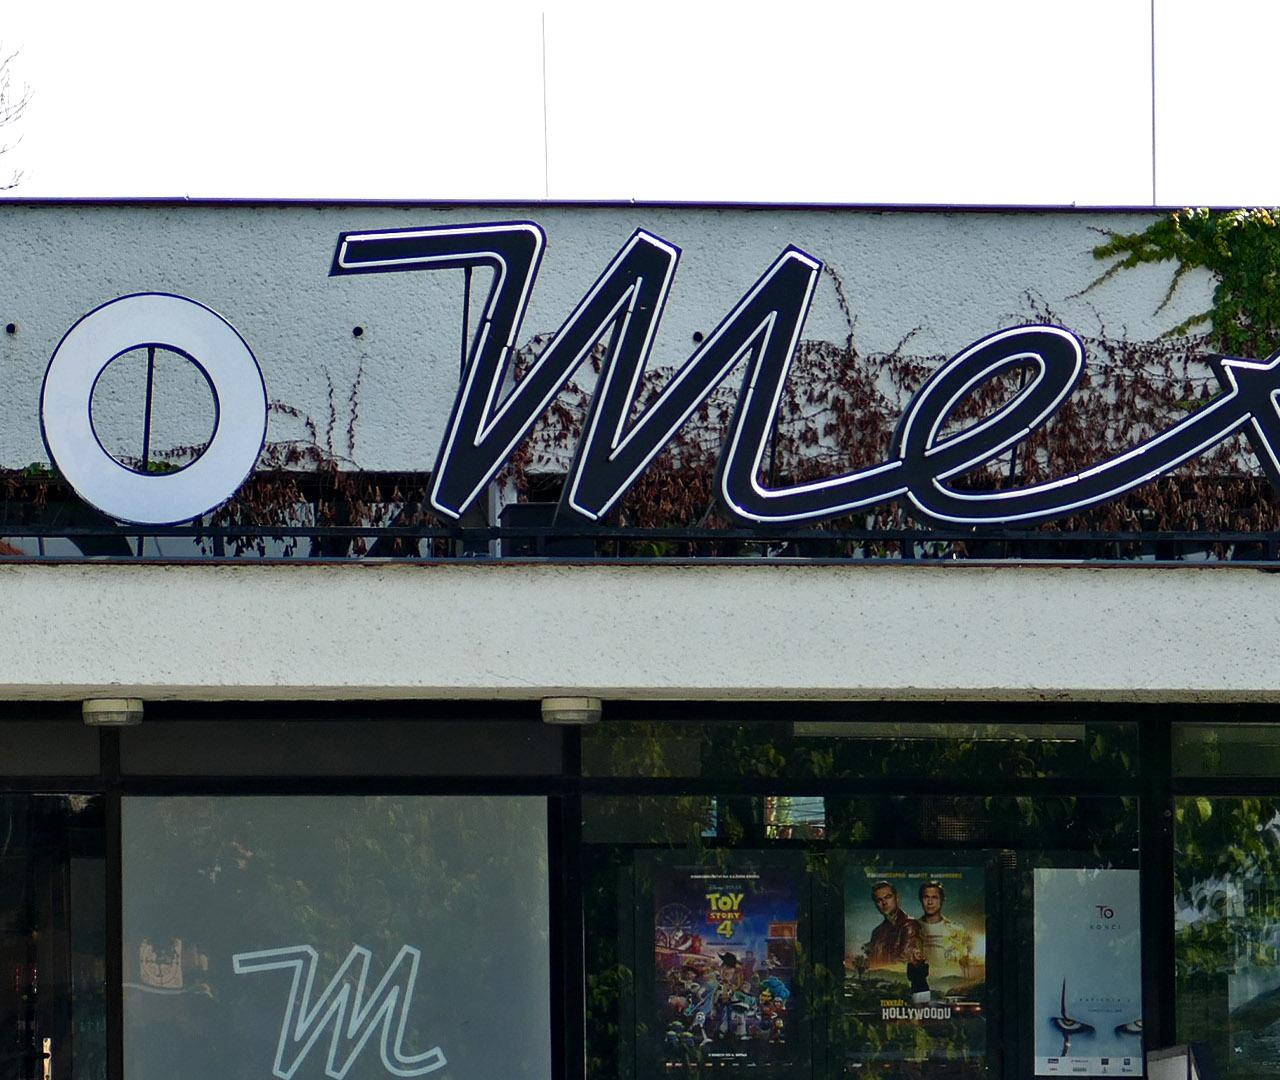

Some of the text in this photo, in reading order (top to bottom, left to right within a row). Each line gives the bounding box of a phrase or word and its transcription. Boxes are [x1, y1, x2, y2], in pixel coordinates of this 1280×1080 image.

[705, 893, 744, 911] TOY
[716, 920, 734, 938] 4
[882, 1007, 951, 1020] HOLLYWOODU
